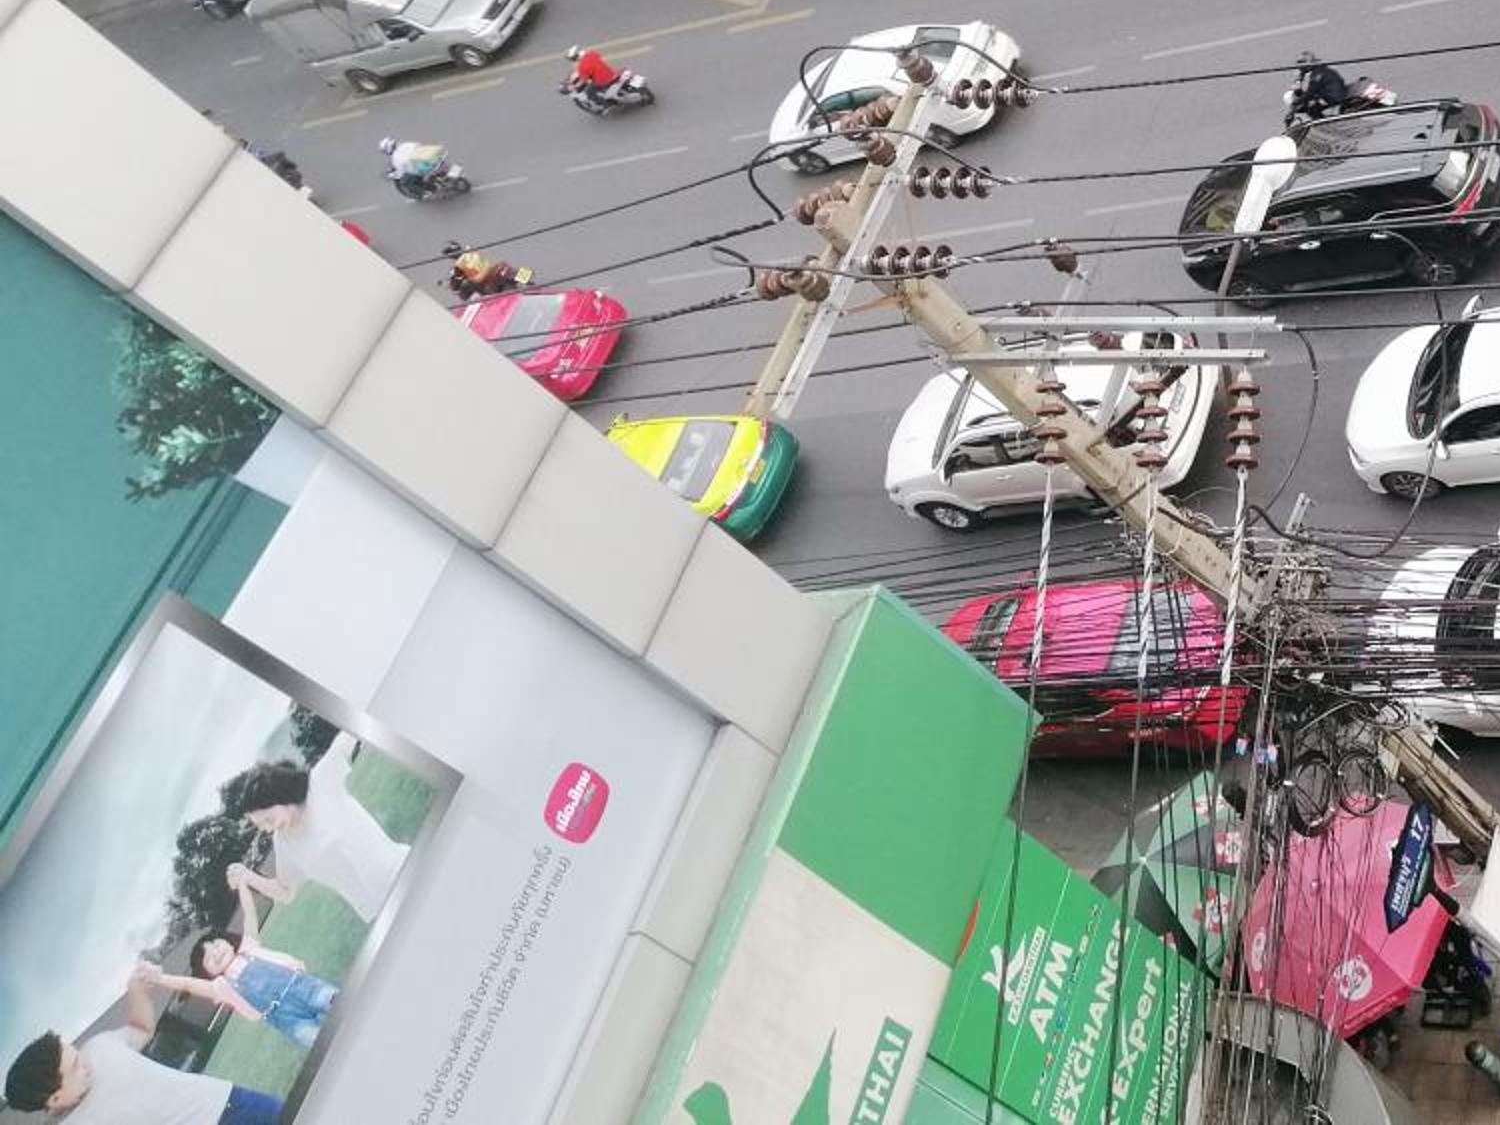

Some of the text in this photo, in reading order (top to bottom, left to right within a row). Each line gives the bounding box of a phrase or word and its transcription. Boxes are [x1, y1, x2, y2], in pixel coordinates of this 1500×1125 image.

[555, 769, 592, 834] เมืองไทย
[1407, 812, 1426, 840] 17
[1028, 940, 1073, 1045] ATM
[1055, 918, 1131, 1125] EXCHANGE
[852, 1028, 907, 1122] THAI
[1139, 981, 1193, 1125] ERNATIONAL
